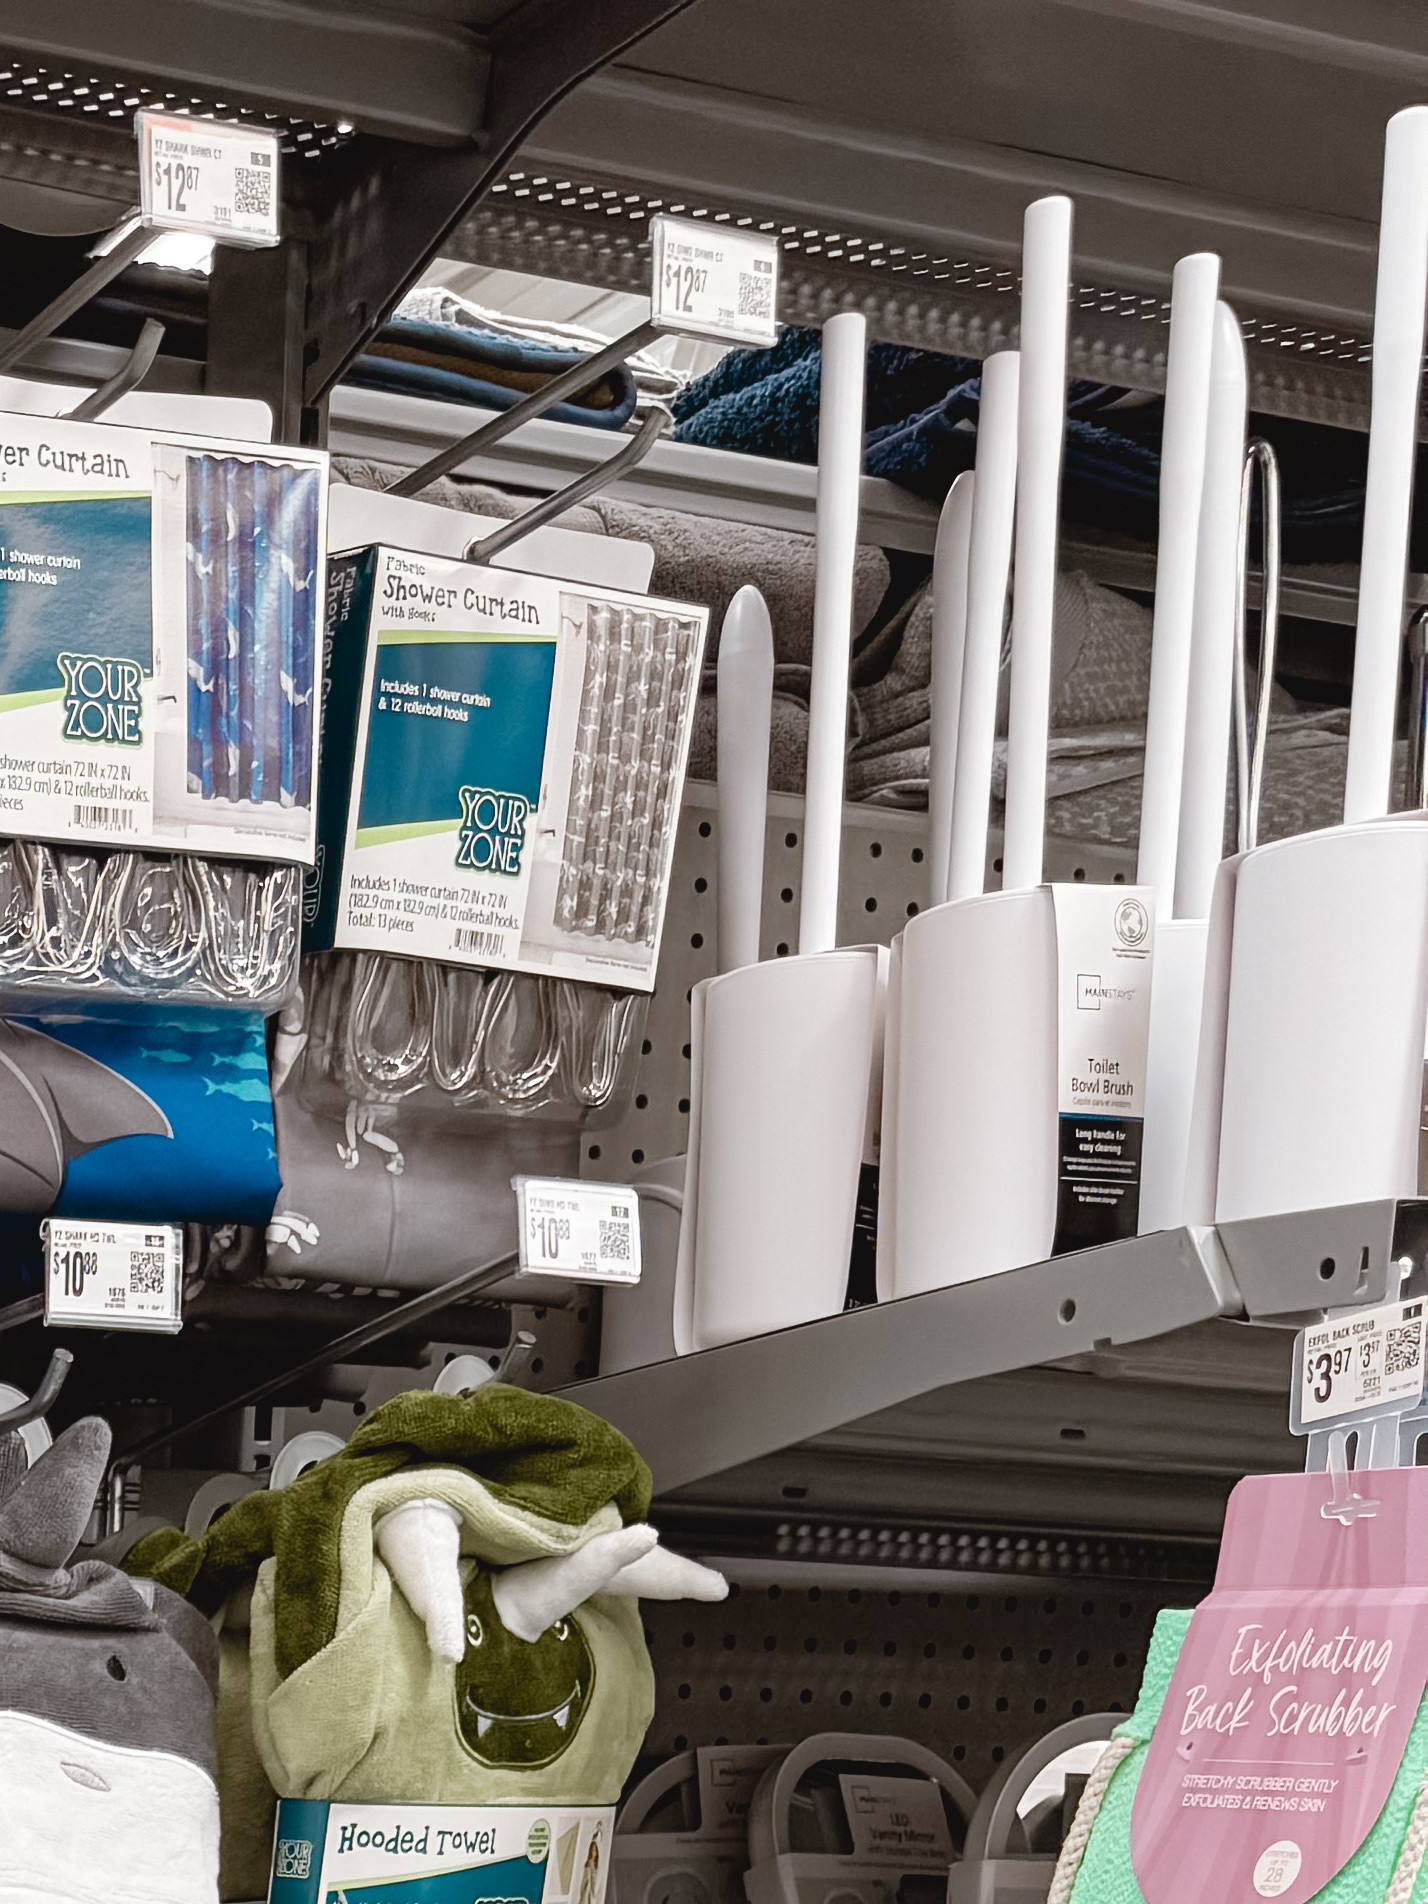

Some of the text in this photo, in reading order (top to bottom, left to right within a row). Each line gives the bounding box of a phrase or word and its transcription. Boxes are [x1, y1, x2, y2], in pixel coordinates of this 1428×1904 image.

[37, 445, 130, 479] Curtain
[387, 556, 425, 575] Fabric
[383, 575, 540, 625] Shower Curtain
[64, 661, 139, 701] YOUR
[67, 702, 139, 741] ZONE
[464, 793, 524, 834] YOUR
[458, 831, 520, 872] ZONE
[1088, 1059, 1120, 1076] Toilet
[1072, 1078, 1134, 1097] Bowl Brush
[1230, 1624, 1394, 1686] Exfoliating
[1180, 1684, 1397, 1737] Back Scrubber
[338, 1823, 496, 1855] Hooded Towel
